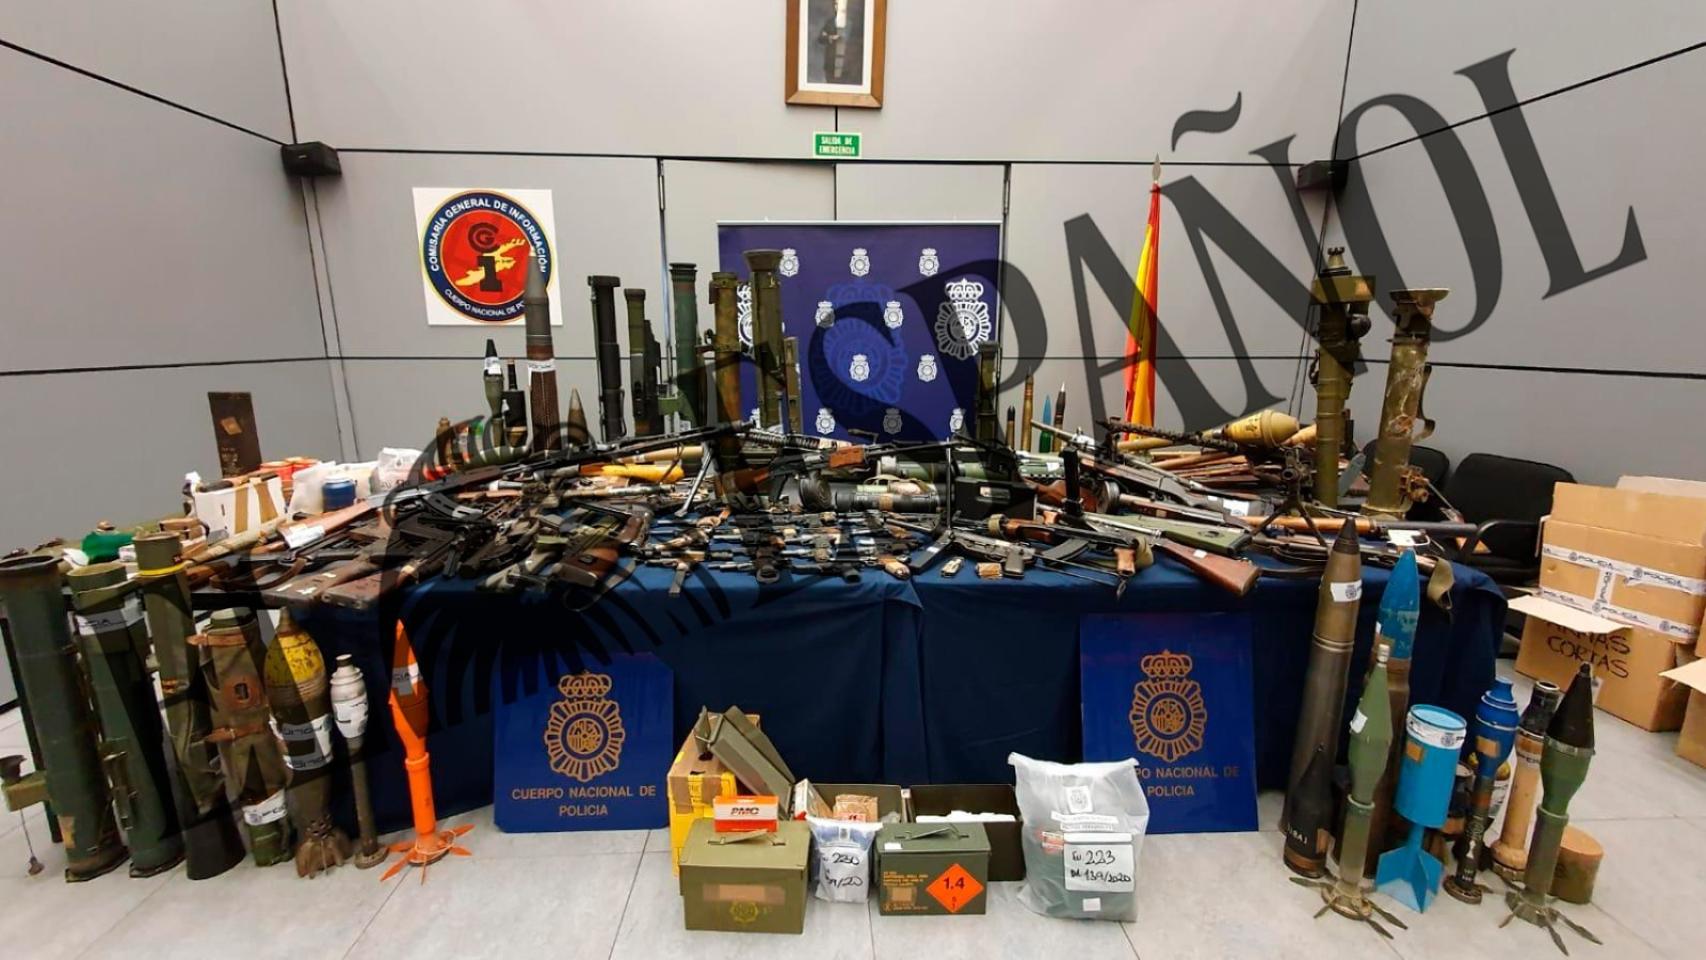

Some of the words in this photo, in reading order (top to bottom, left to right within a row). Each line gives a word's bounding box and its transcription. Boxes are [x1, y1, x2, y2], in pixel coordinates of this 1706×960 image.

[445, 197, 492, 219] GENERAL
[493, 200, 509, 213] DE
[444, 288, 472, 311] CUERPO
[471, 304, 507, 317] NACIONAL
[506, 305, 517, 315] DE
[1547, 636, 1629, 678] CORTAS
[1155, 767, 1218, 779] NACIONAL
[1223, 766, 1240, 778] DE
[512, 788, 564, 800] CUERPO
[569, 786, 633, 799] NACIONAL
[639, 785, 656, 797] DE
[1147, 784, 1195, 797] POLICIA
[559, 804, 608, 817] POLICIA
[731, 807, 760, 816] PMC
[1085, 849, 1116, 865] 223
[944, 877, 965, 890] 1.4
